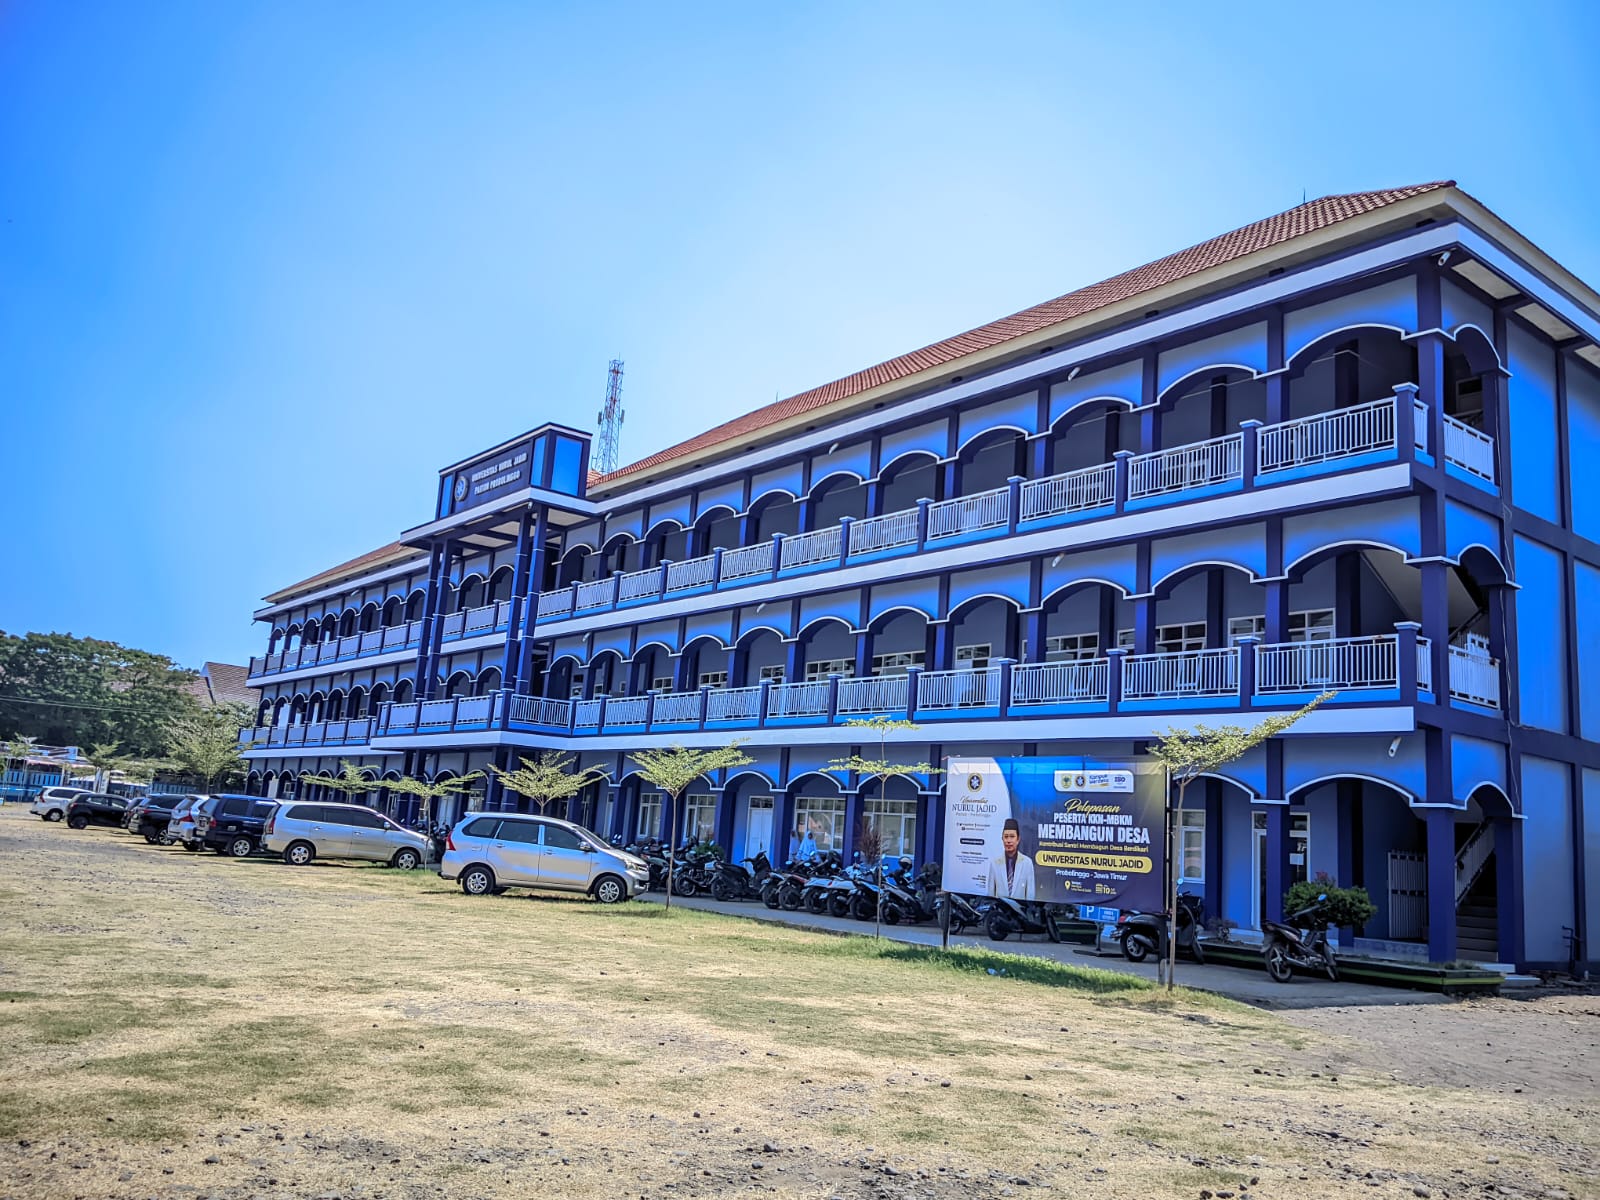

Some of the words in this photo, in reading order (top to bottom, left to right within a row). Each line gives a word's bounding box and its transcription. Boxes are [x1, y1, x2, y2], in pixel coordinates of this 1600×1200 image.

[951, 803, 975, 812] NURUL
[976, 804, 998, 813] JADID
[1064, 798, 1121, 818] Pelepasan
[1053, 812, 1087, 823] PESERTA
[1088, 813, 1133, 826] KKN-MBKM
[1038, 823, 1114, 842] MEMBANGUN
[1117, 827, 1151, 844] DESA
[1042, 854, 1090, 866] UNIVERSITAS
[1091, 858, 1117, 867] NURUL
[1119, 859, 1144, 869] JADID
[1055, 869, 1090, 879] Probolinggo
[1093, 872, 1109, 880] Jawa
[1110, 873, 1128, 881] Timur
[1086, 905, 1095, 919] P
